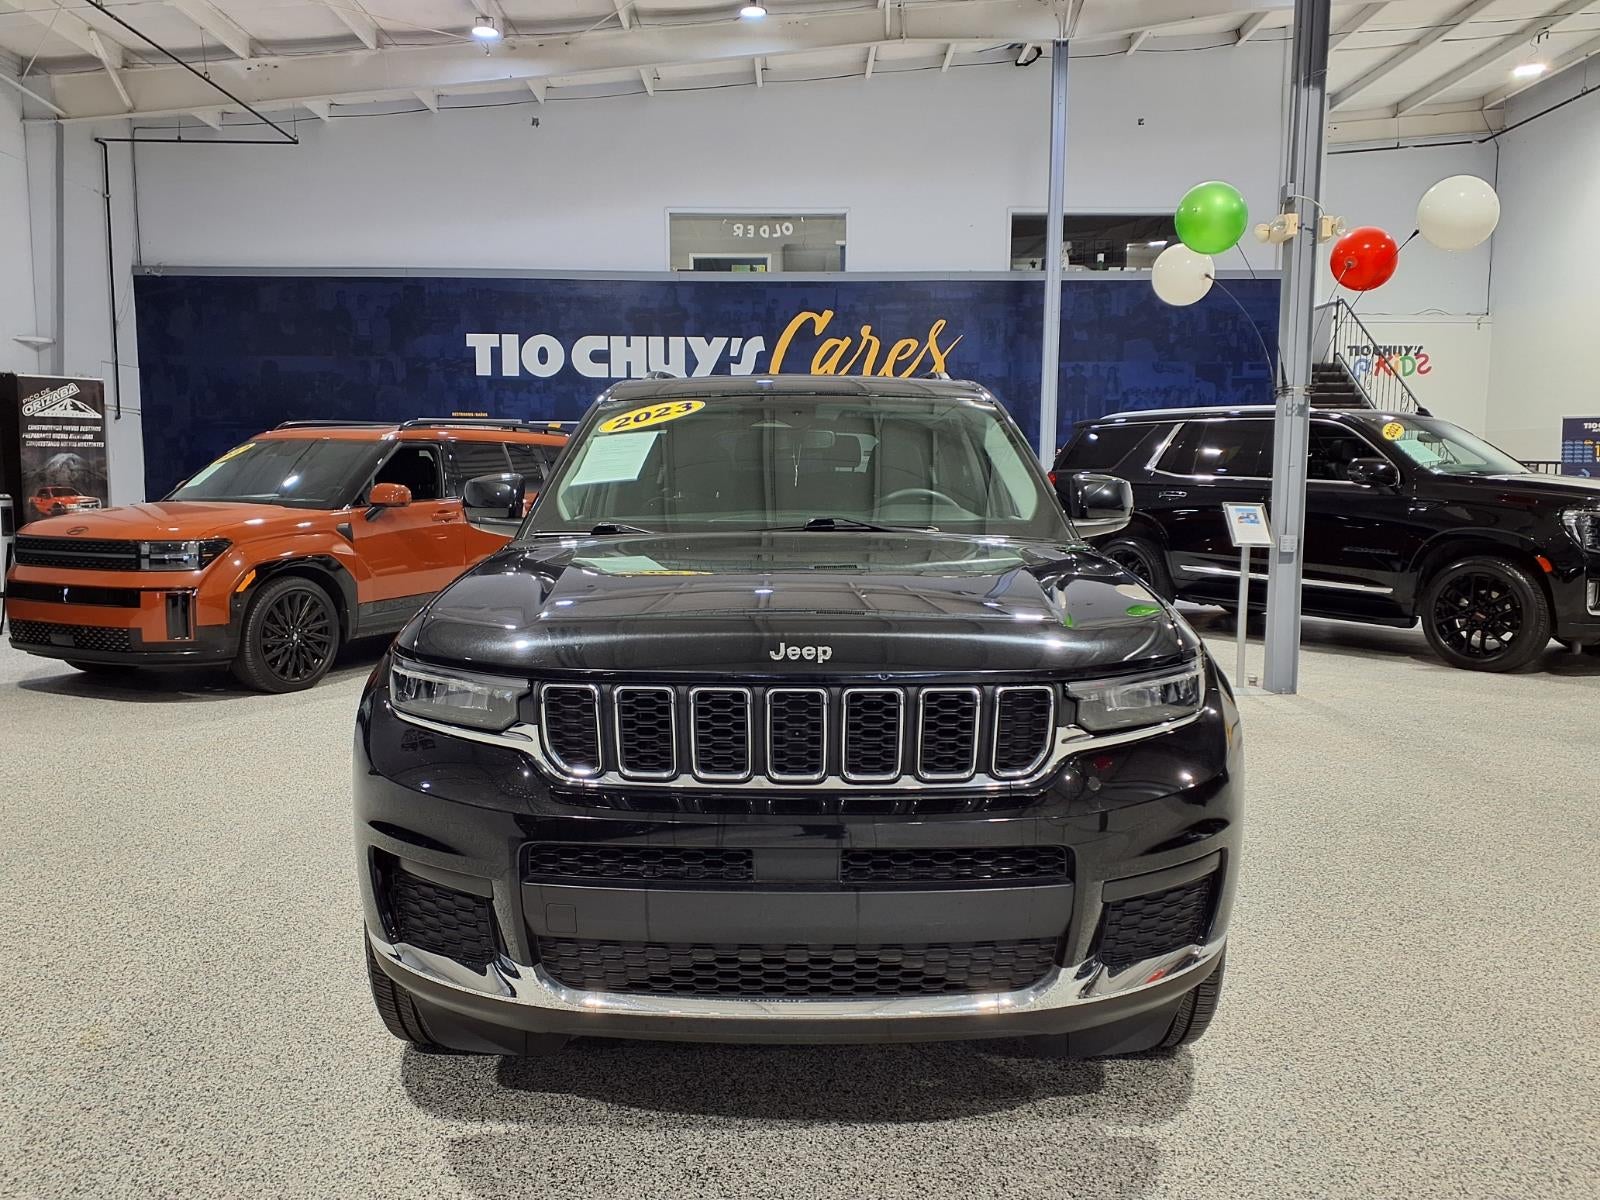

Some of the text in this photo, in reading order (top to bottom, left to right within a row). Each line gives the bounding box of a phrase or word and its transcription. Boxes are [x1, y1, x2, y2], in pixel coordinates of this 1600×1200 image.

[465, 309, 964, 378] TIO CHUY'S Cares
[22, 393, 40, 404] PICO
[22, 383, 79, 416] ORIZABA
[613, 402, 693, 430] 2023
[769, 642, 833, 664] Jeep
